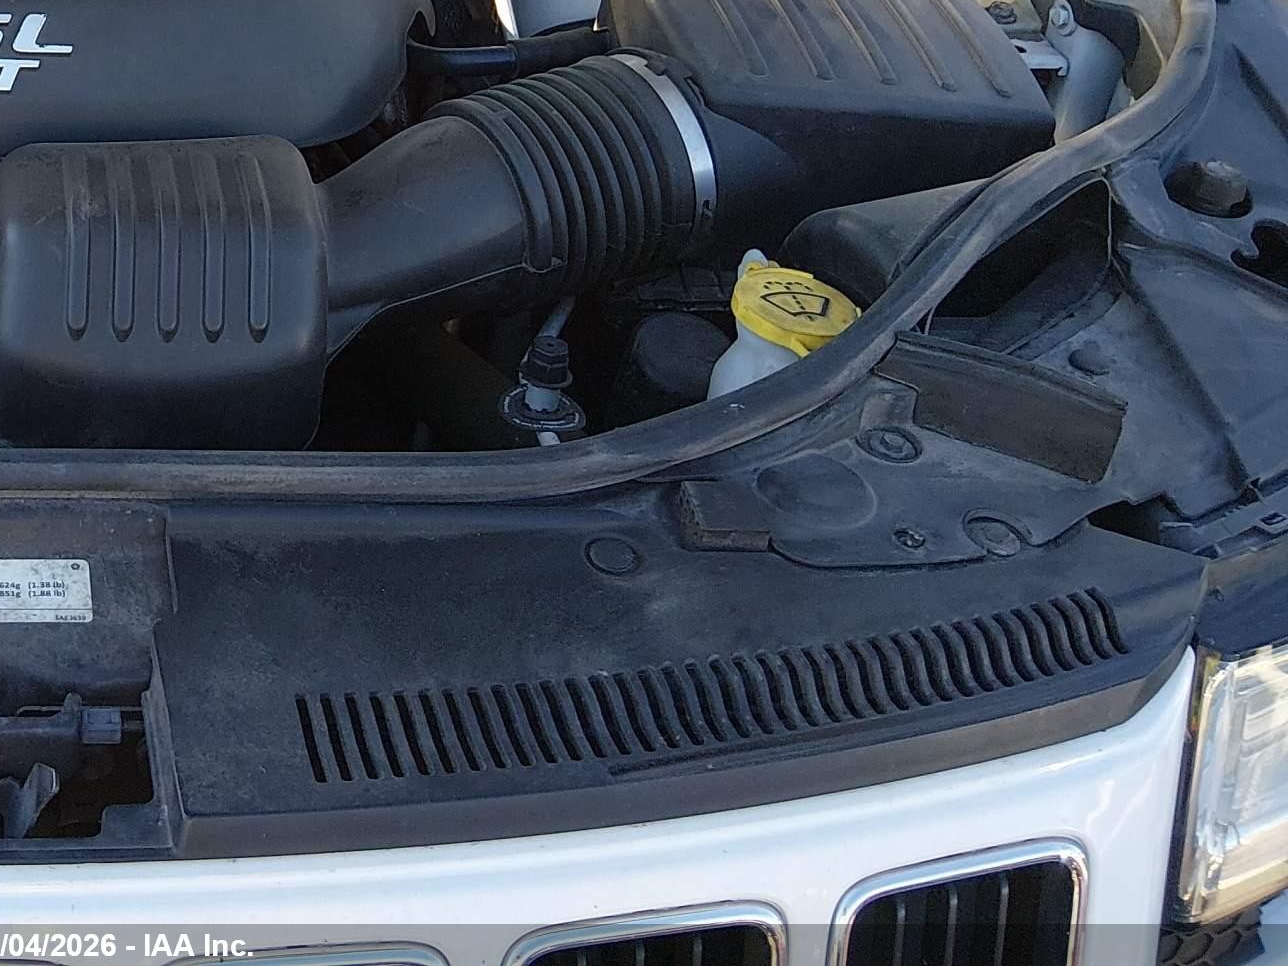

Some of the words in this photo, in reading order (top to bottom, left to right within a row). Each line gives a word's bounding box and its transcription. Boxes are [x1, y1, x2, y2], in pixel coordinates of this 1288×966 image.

[0, 582, 21, 590] 624g
[28, 581, 51, 590] (1.38
[0, 590, 22, 598] 851g
[52, 590, 66, 599] lb)
